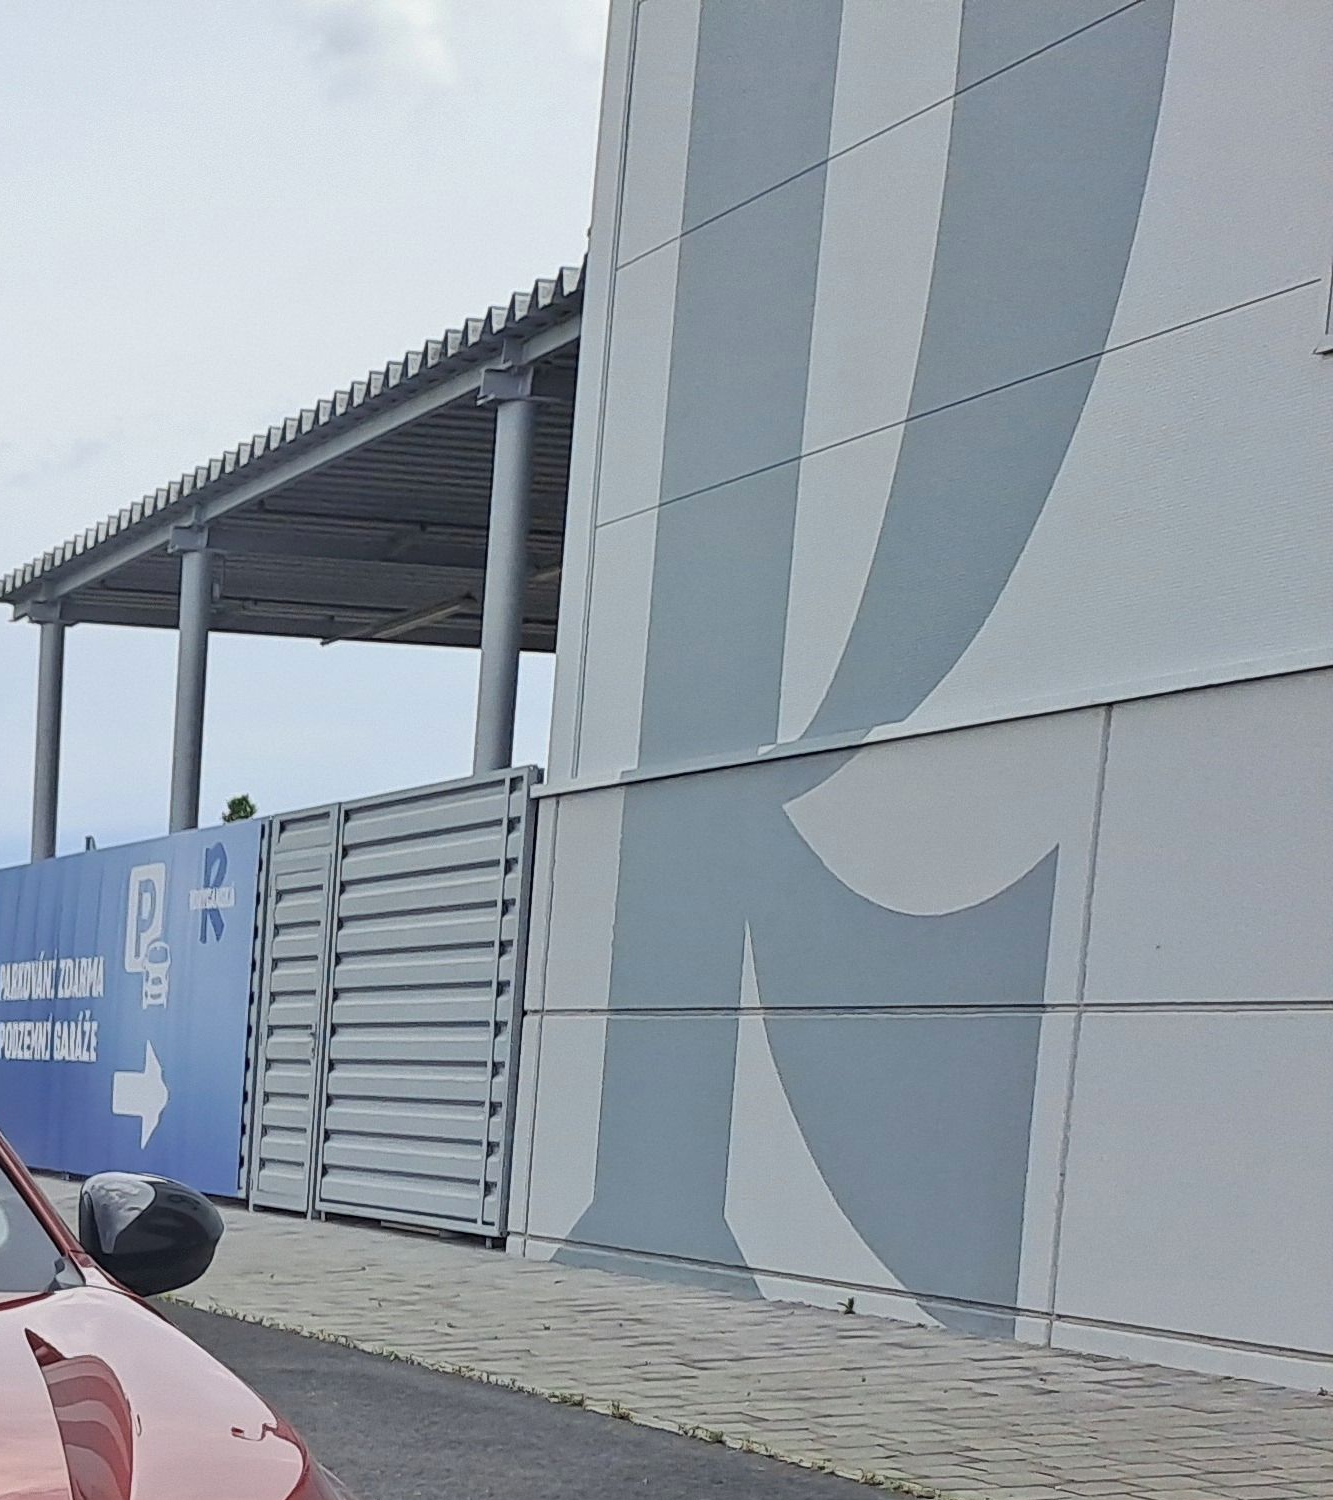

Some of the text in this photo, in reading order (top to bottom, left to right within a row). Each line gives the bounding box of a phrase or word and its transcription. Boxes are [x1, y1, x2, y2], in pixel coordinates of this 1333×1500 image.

[0, 949, 104, 1001] PARKOVÁNÍ ZDARMA
[54, 1010, 97, 1062] GARÁŽE
